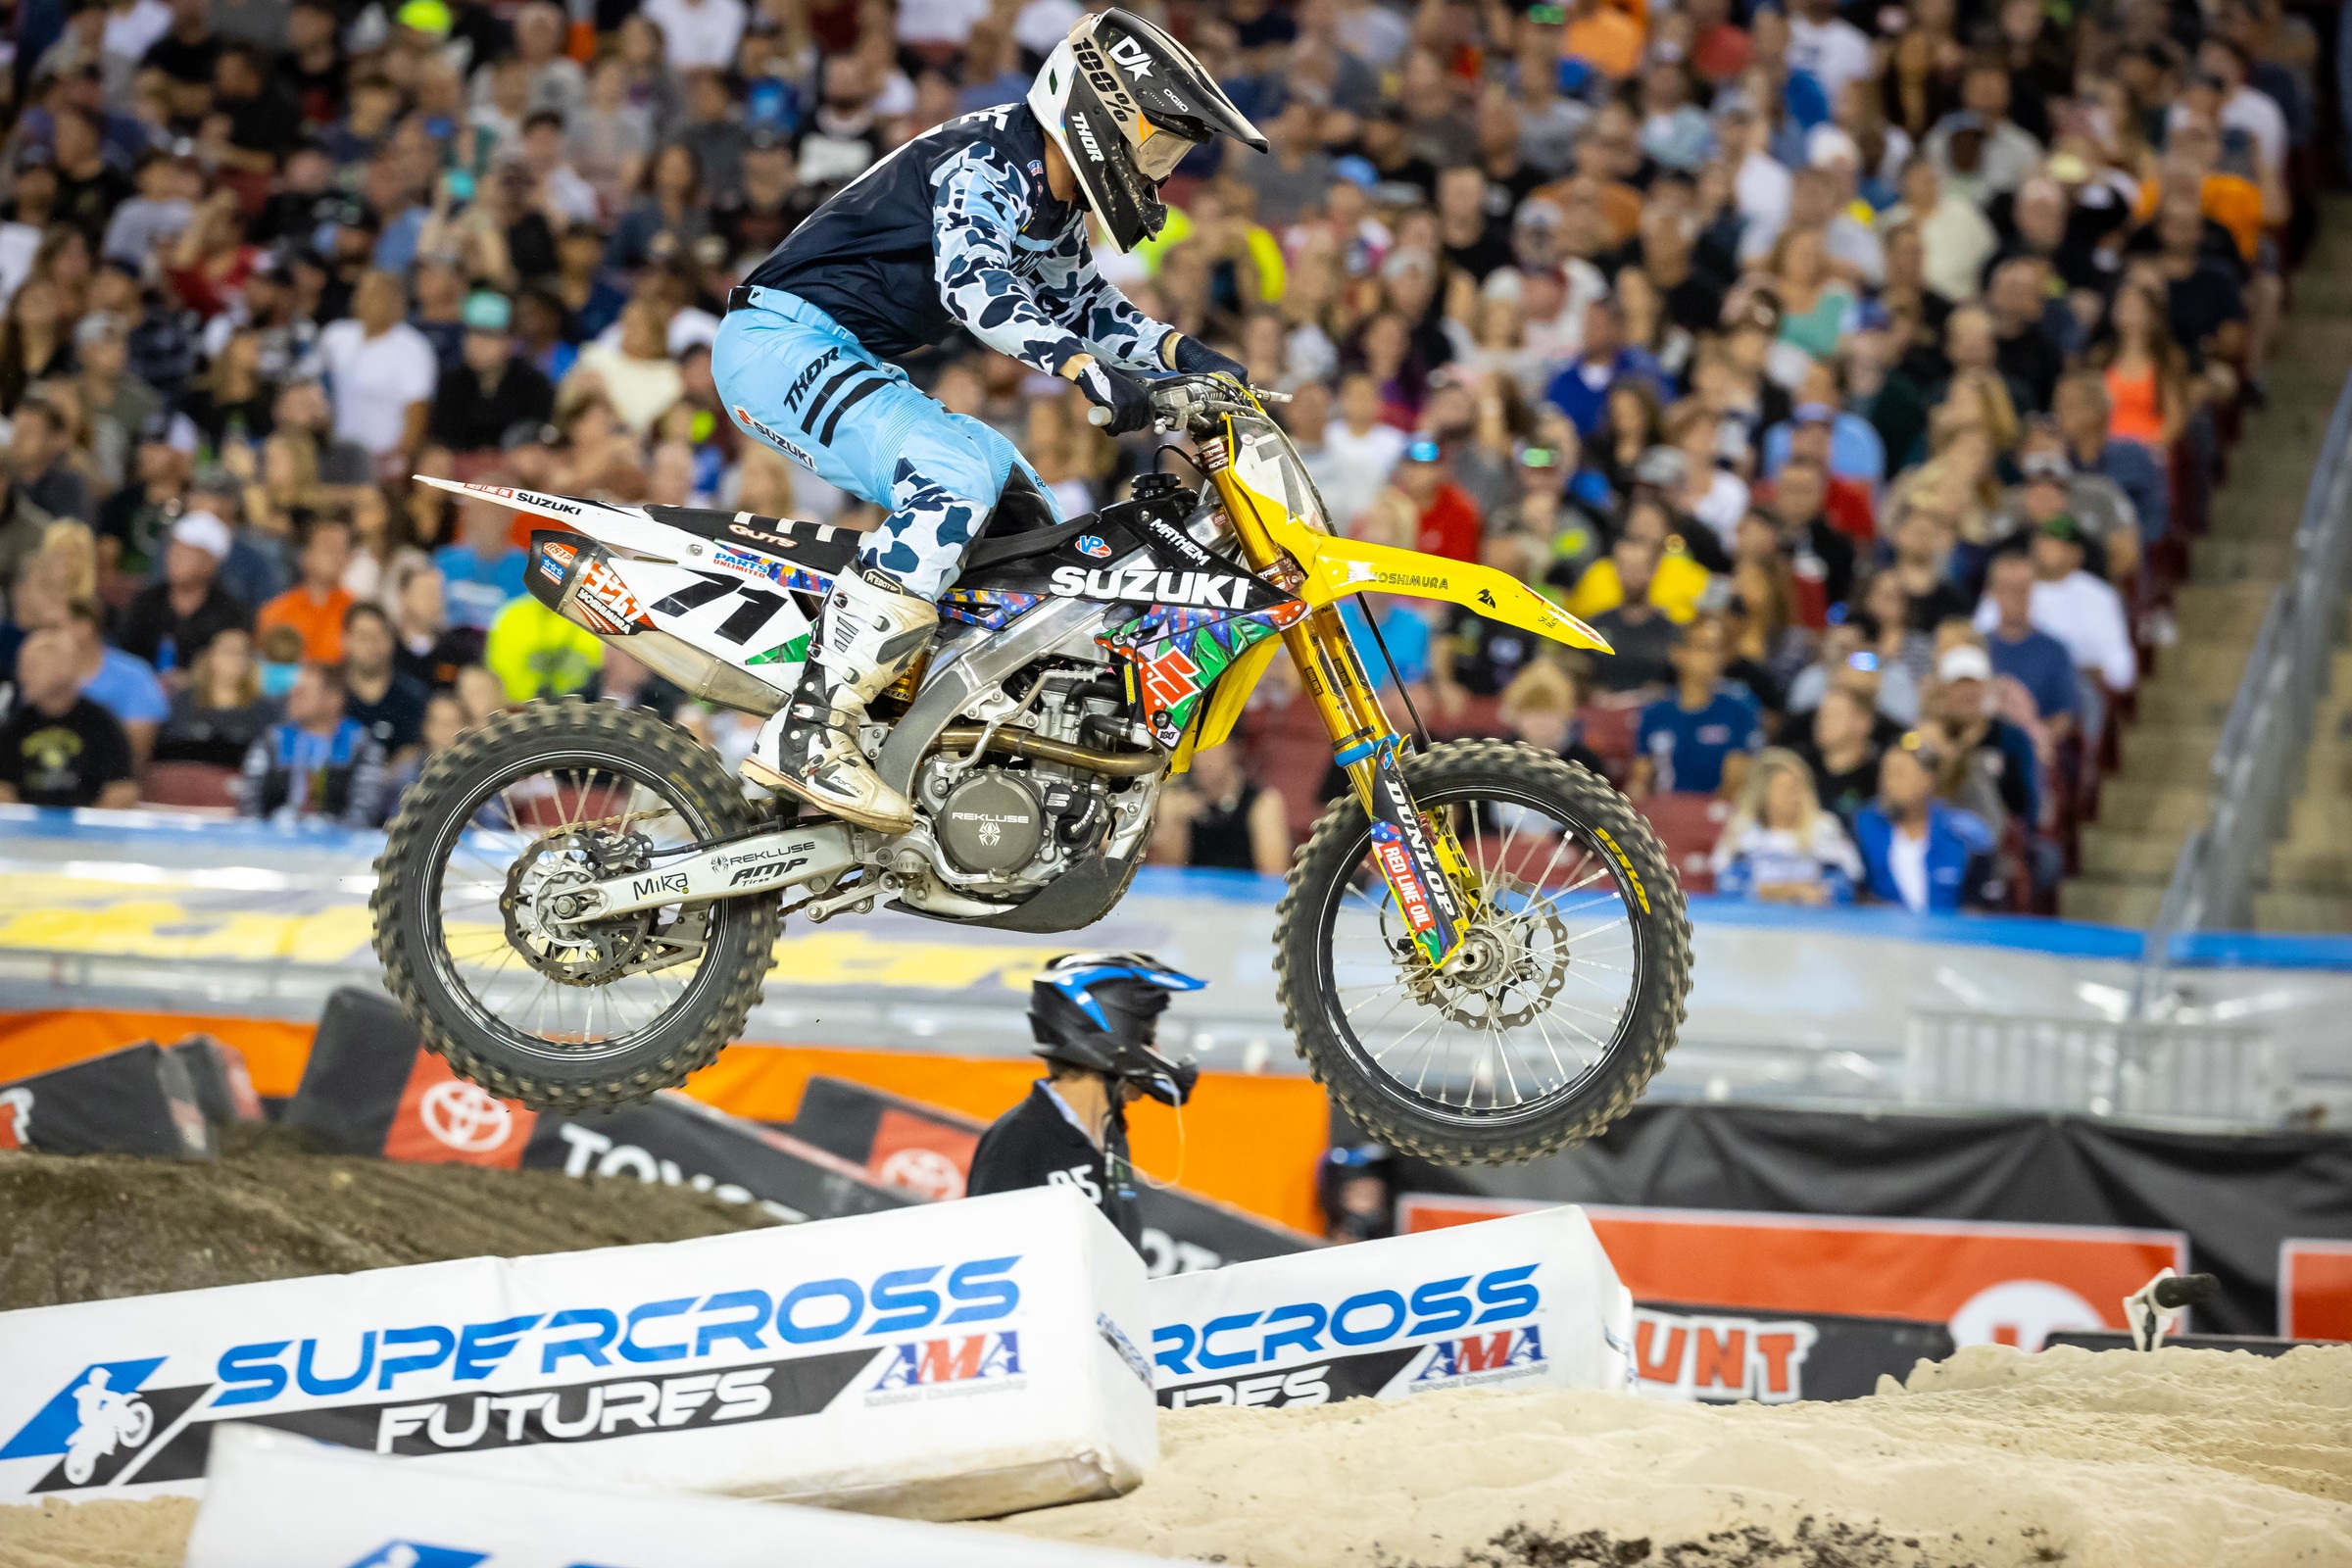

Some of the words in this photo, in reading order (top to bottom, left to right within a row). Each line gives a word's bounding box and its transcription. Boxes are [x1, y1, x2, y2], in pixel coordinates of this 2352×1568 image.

[1072, 37, 1136, 122] 100%
[1163, 88, 1189, 113] OGIO
[1070, 111, 1104, 162] THOR
[783, 346, 840, 415] THOR
[754, 421, 813, 467] SUZUKI
[480, 484, 499, 494] LINE
[498, 487, 511, 497] OIL
[515, 492, 582, 515] SUZUKI
[728, 524, 798, 548] GUTS
[1079, 535, 1104, 554] VP
[1150, 517, 1211, 566] MAYHEM
[712, 559, 765, 579] UNLIMITED
[714, 552, 771, 574] PARTS
[650, 570, 788, 646] 71
[1049, 565, 1251, 610] SUZUKI
[576, 588, 631, 635] YOSHIMURA
[952, 811, 1029, 824] REKLUSE
[730, 841, 815, 866] REKLUSE
[1385, 779, 1455, 916] DUNLOP
[729, 858, 808, 887] AMP
[1383, 846, 1407, 874] RED
[1396, 877, 1416, 905] LINE
[1409, 905, 1429, 928] OIL
[208, 1255, 1023, 1407] SUPERCROSS
[1152, 1262, 1542, 1375] RCROSS
[868, 1330, 1026, 1392] AMA
[1411, 1325, 1544, 1381] AMA
[377, 1367, 774, 1454] FUTURES
